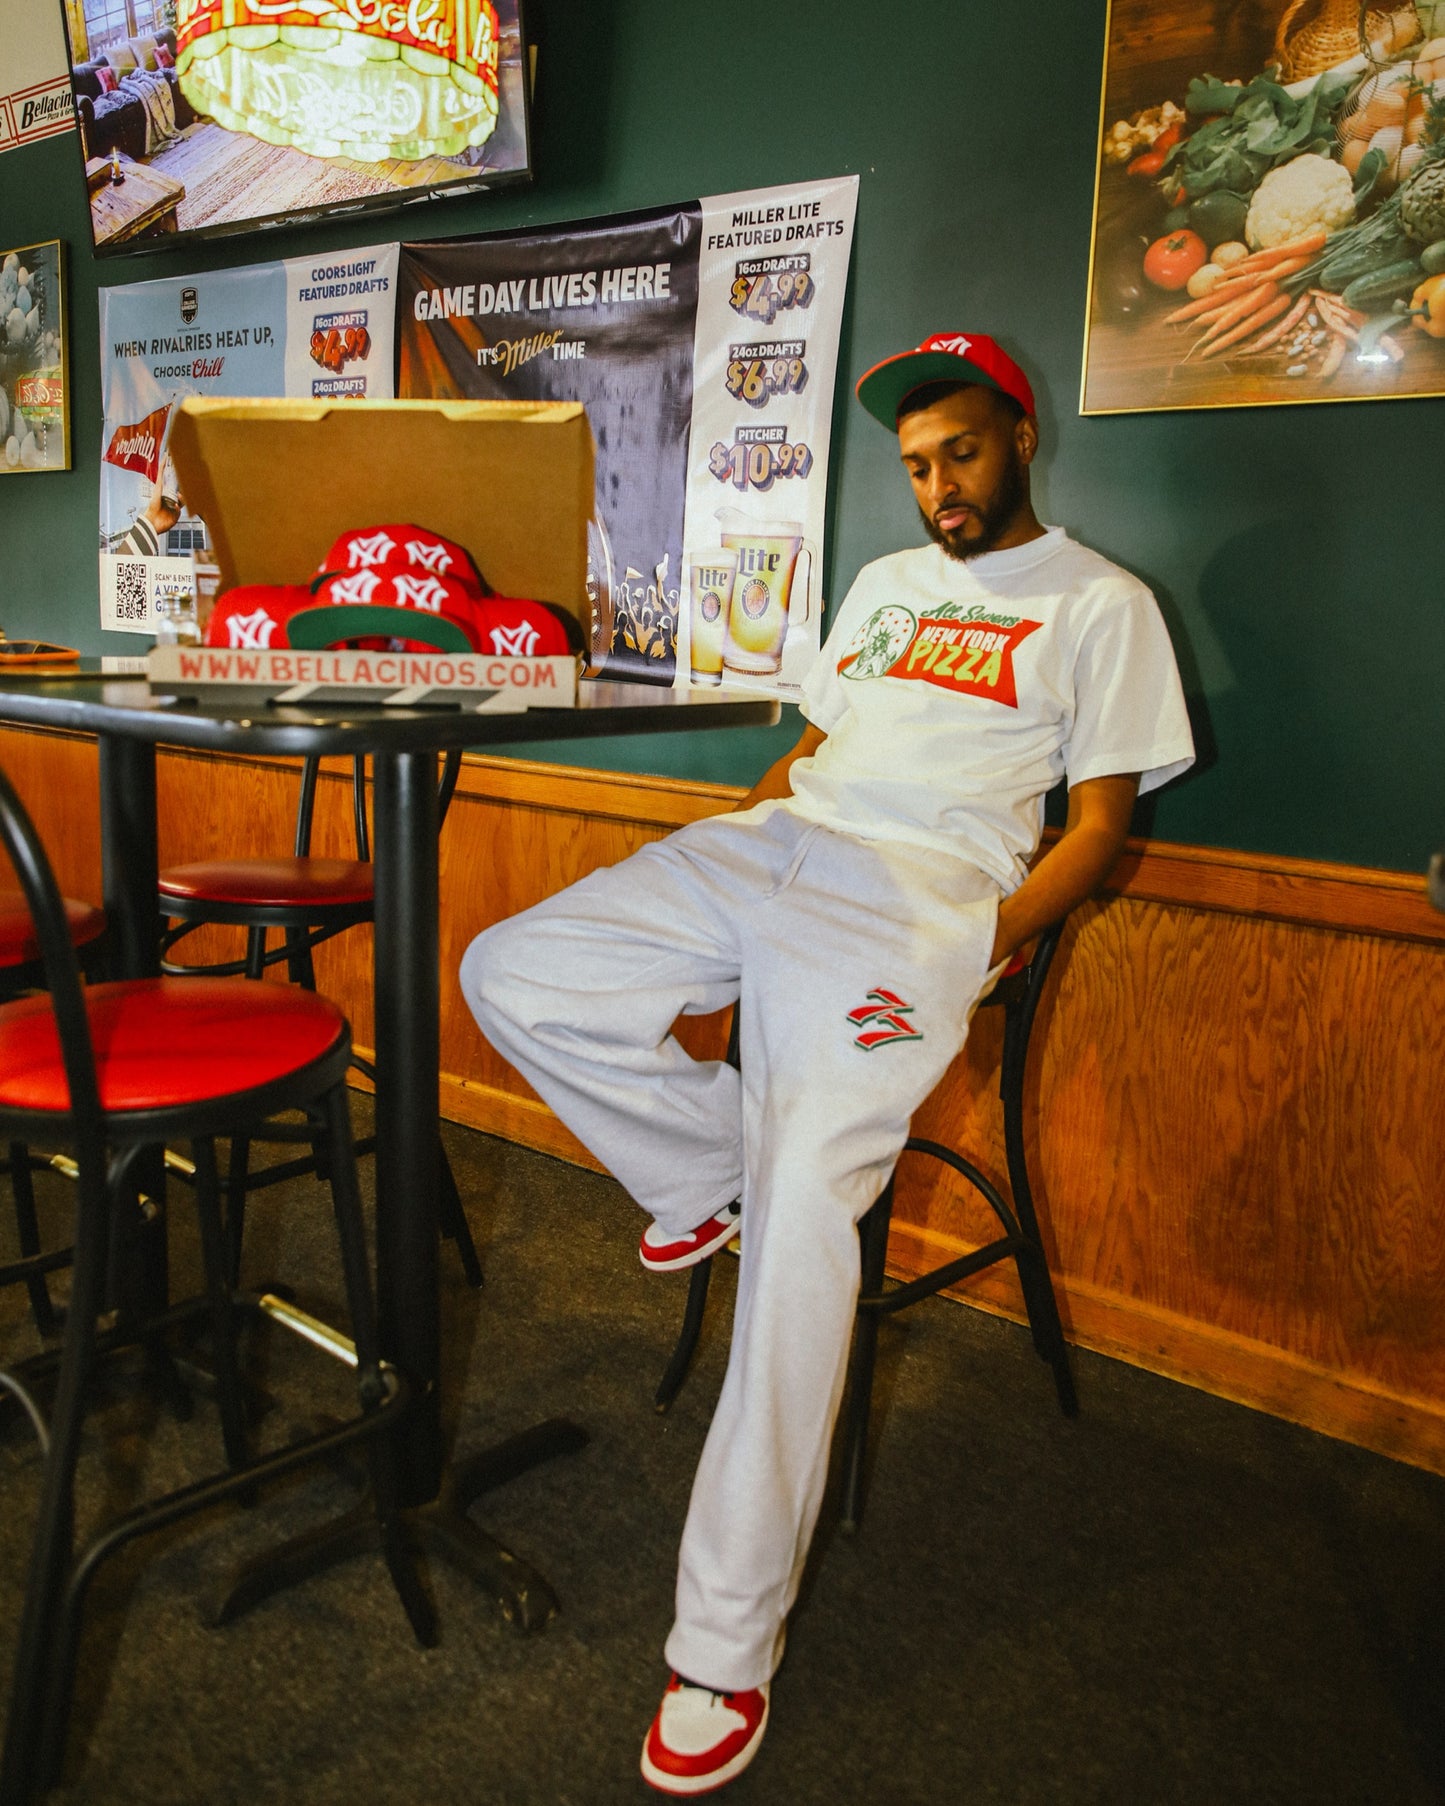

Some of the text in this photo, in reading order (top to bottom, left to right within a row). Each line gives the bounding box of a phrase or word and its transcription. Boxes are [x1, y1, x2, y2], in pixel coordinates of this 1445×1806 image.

[21, 90, 74, 130] Bellacin
[732, 202, 821, 228] MILLER LITE
[708, 220, 844, 250] FEATURED DRAFTS
[311, 260, 377, 281] COORS LIGHT
[738, 256, 808, 275] 16oz DRAFTS
[299, 278, 389, 301] FEATURED DRAFTS
[413, 262, 671, 322] GAME DAY LIVES HERE
[731, 273, 814, 322] $4.99
[315, 313, 366, 329] 16oz DRAFTS
[114, 326, 275, 359] WHEN RIVALRIES HEAT UP,
[310, 327, 370, 373] $4.99
[477, 329, 586, 377] IT'S Miller TIME
[731, 342, 803, 358] 24oz DRAFTS
[153, 356, 225, 379] CHOOSE Chill
[314, 379, 365, 393] 24oz DRAFTS
[726, 359, 808, 407] $6.99
[738, 428, 784, 441] PITCHER
[709, 442, 812, 490] $10.99
[347, 531, 397, 568] NY
[738, 547, 781, 577] Lite
[178, 574, 192, 583] ENTE
[330, 567, 382, 604] NY
[392, 573, 449, 612] NY
[698, 567, 728, 591] Lite
[920, 601, 963, 620] All
[917, 626, 1011, 653] NEW YORK
[178, 652, 557, 689] WWW.BELLACINOS.COM
[906, 640, 1002, 687] PIZZA
